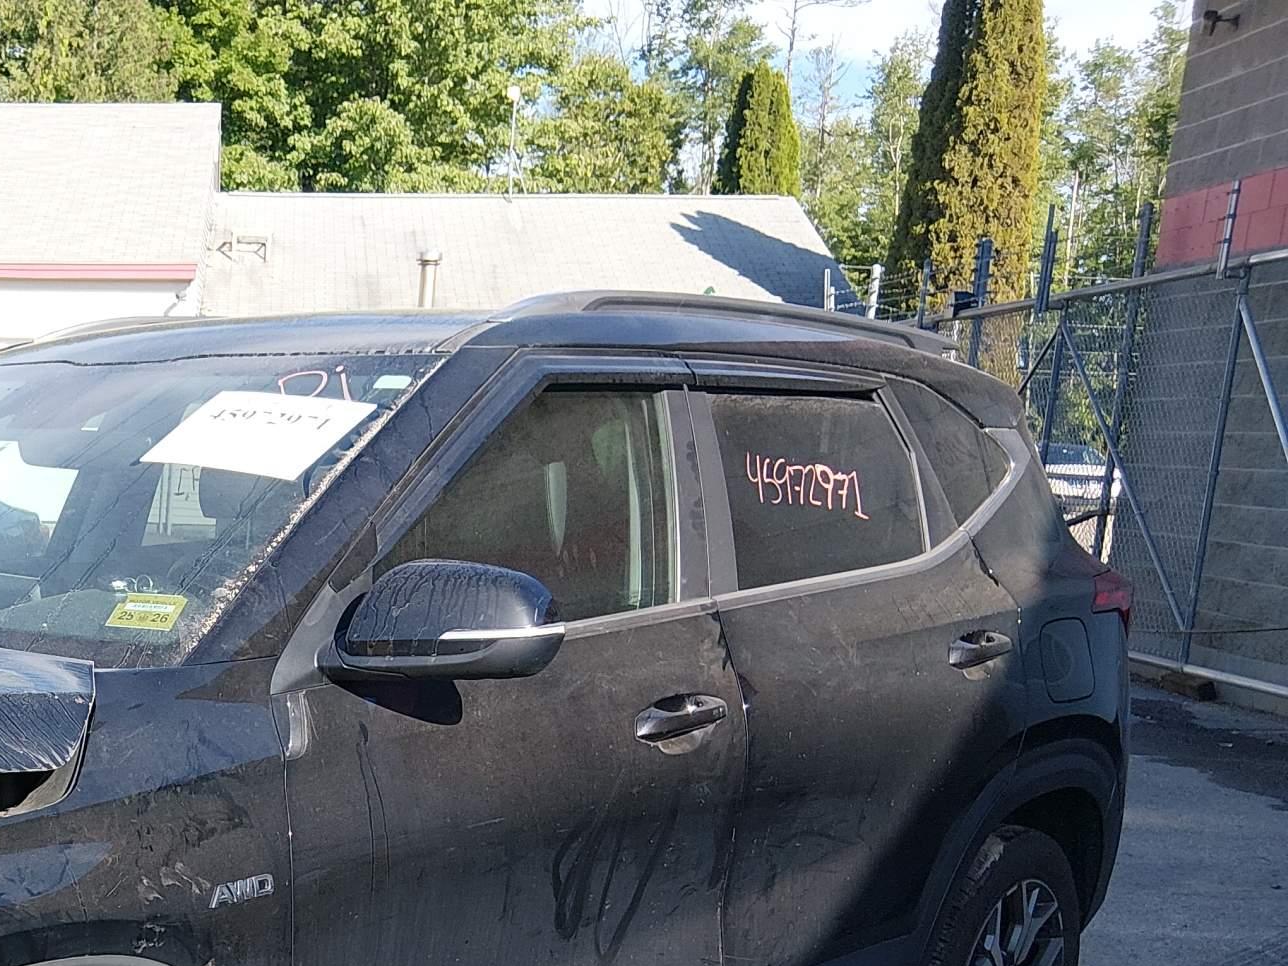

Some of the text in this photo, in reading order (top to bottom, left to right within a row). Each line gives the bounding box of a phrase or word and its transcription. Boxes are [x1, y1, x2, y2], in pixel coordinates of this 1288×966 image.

[746, 451, 870, 520] 45972971
[118, 611, 170, 623] 25 26
[208, 873, 275, 909] AWD
